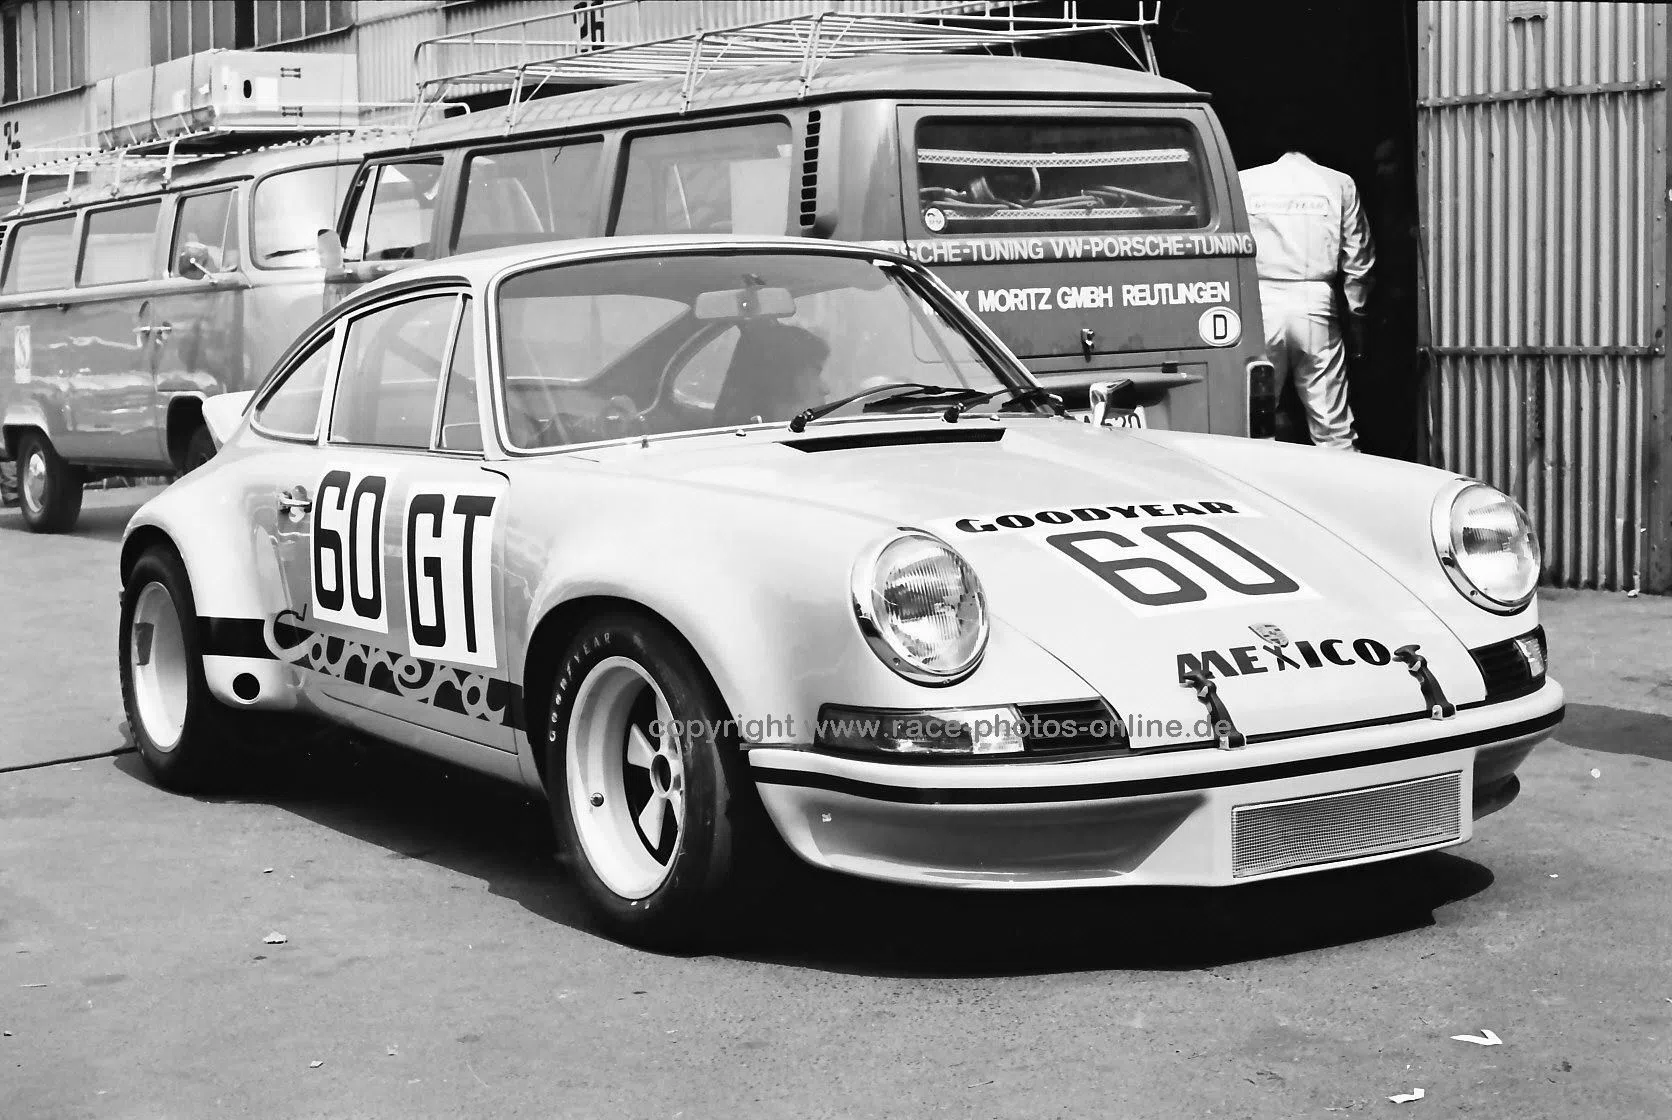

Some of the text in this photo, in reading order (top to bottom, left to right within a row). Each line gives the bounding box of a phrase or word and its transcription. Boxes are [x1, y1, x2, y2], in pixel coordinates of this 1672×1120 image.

[1049, 234, 1253, 260] VW-PORSCHE-TUNING
[977, 288, 1053, 312] MORITZ
[1056, 286, 1114, 309] GMBH
[1122, 281, 1231, 307] REUTLINGEN
[1213, 314, 1228, 340] D
[955, 501, 1241, 533] GOODYEAR
[313, 470, 497, 653] 60 GT
[1046, 524, 1300, 607] 60
[263, 603, 508, 725] Carrera
[1176, 638, 1392, 683] MEXICO
